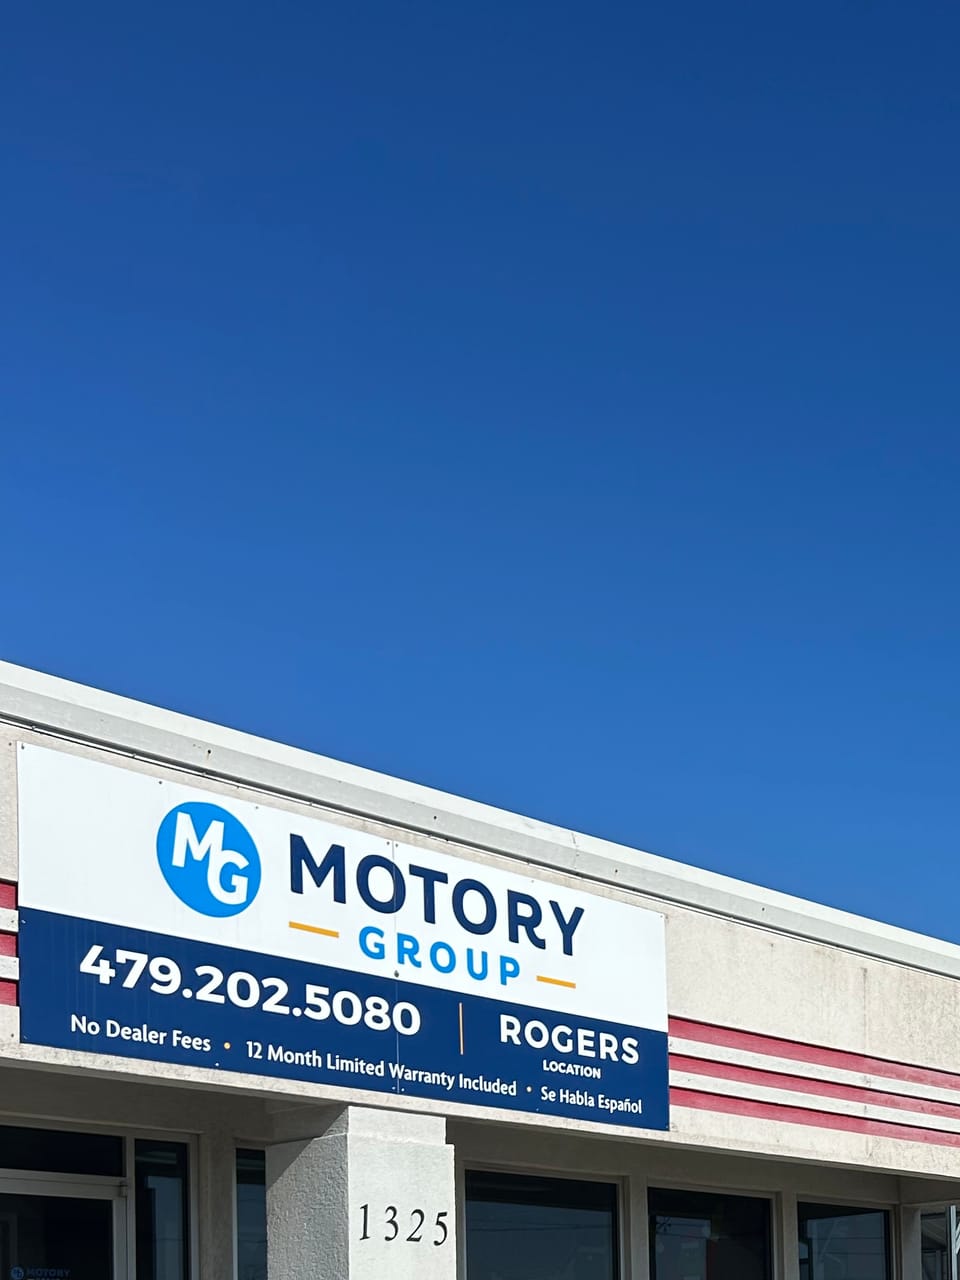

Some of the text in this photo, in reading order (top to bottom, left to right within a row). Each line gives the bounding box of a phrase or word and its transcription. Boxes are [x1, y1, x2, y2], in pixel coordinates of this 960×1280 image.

[171, 811, 249, 905] MG
[290, 833, 585, 956] MOTORY
[358, 926, 521, 986] GROUP
[80, 945, 422, 1036] 479.202.5080
[70, 1014, 211, 1051] No Dealer Fees
[500, 1014, 640, 1065] ROGERS
[246, 1041, 517, 1096] 12 Month Limited Warranty Included
[543, 1059, 601, 1079] LOCATION
[541, 1086, 643, 1114] Se Habla Español
[360, 1203, 448, 1246] 1325
